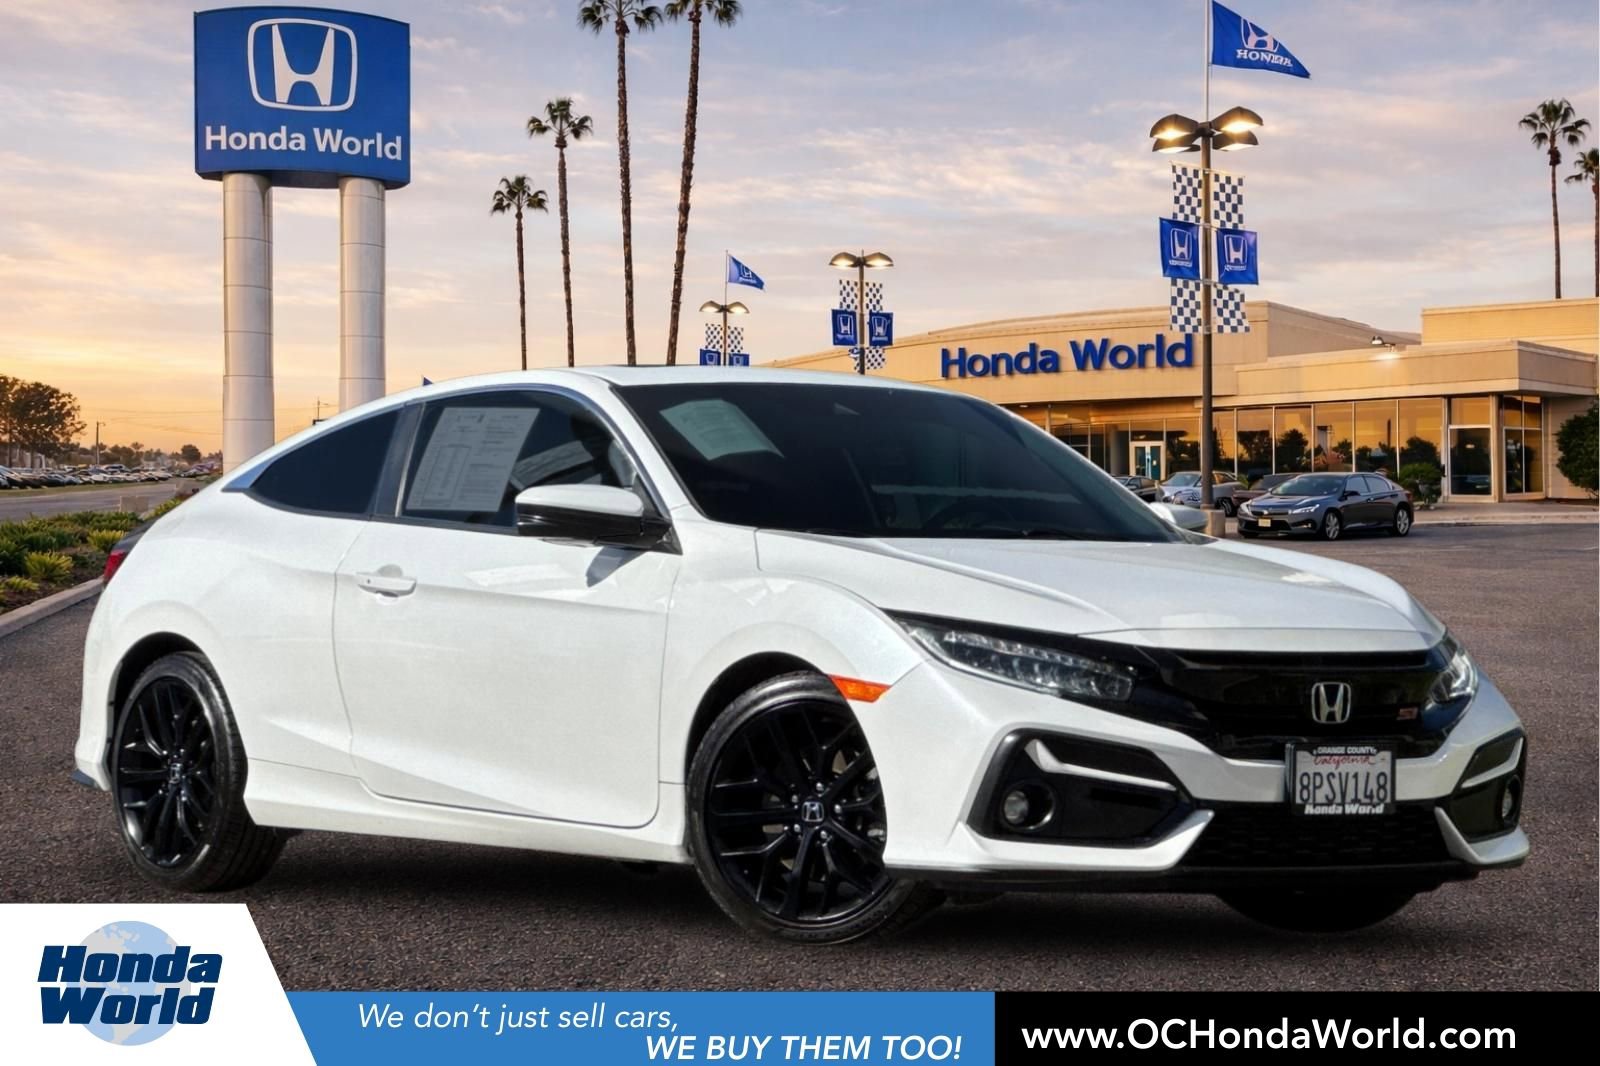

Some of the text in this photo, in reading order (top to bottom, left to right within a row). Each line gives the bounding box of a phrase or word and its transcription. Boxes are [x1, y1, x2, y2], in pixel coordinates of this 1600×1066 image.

[205, 125, 402, 161] Honda World
[941, 333, 1194, 378] Honda World
[1313, 754, 1376, 770] California
[1299, 772, 1387, 802] 8PSV148
[1304, 804, 1343, 815] Honda
